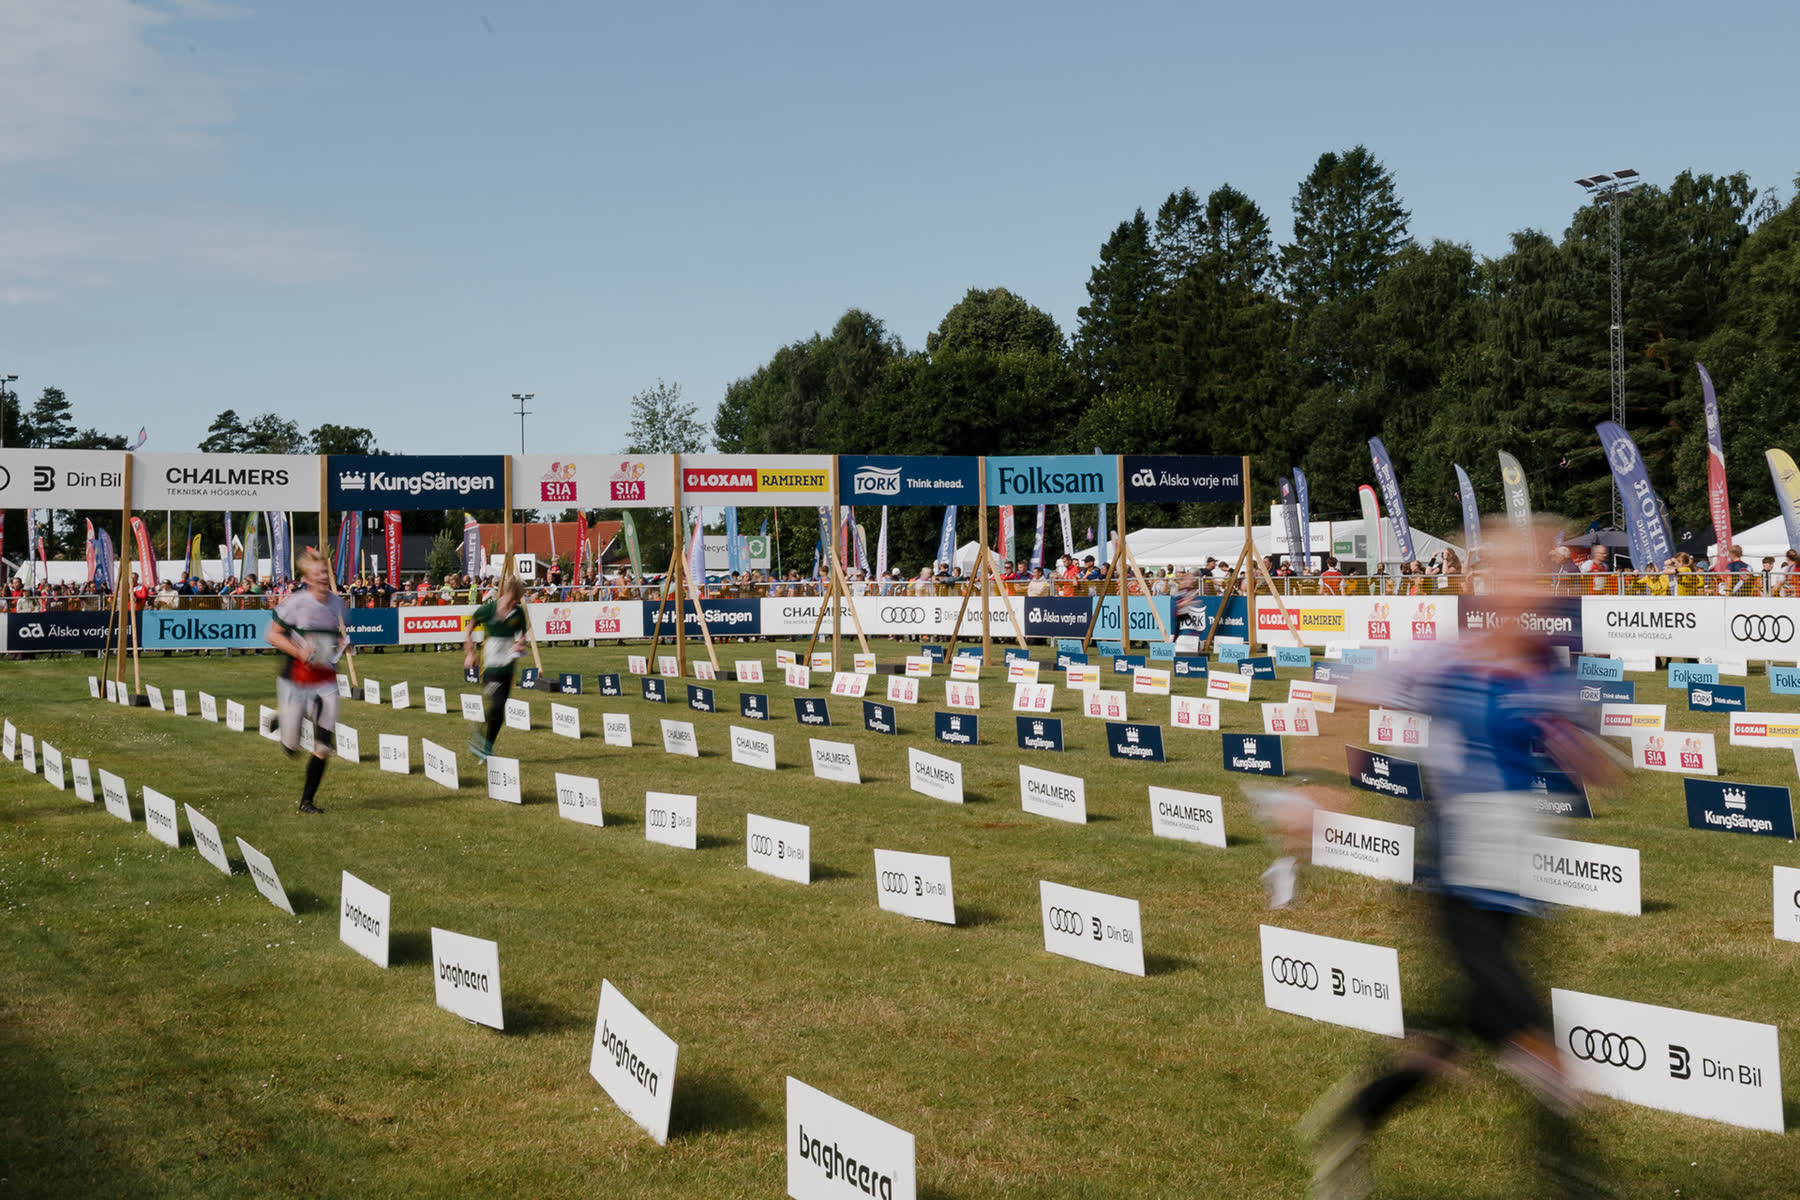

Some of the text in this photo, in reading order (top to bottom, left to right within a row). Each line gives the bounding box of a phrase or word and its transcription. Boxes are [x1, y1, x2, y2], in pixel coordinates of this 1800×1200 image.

[67, 472, 121, 488] Din Bil
[166, 468, 289, 486] CHALMERS
[370, 471, 494, 495] KungSängen
[762, 475, 825, 486] RAMIRENT
[857, 478, 964, 492] TORK Think ahead.
[998, 467, 1104, 495] Folksam
[1160, 471, 1189, 486] Älska
[1192, 474, 1219, 489] varje
[1222, 474, 1238, 486] mil
[167, 487, 258, 497] TEKNISKA HÖGSKOLA
[546, 484, 570, 496] SIA
[616, 482, 640, 496] SIA
[703, 544, 729, 553] Recycl
[599, 620, 616, 629] SIA
[1043, 609, 1060, 623] Älska
[1060, 612, 1076, 626] varje
[1077, 612, 1087, 623] mil
[1303, 615, 1342, 626] RAMIRENT
[1606, 611, 1696, 629] CHALMERS
[48, 624, 80, 637] Älska
[158, 618, 256, 640] Folksam
[356, 624, 384, 633] ahead.
[550, 622, 567, 630] SIA
[1371, 623, 1387, 634] SIA
[1416, 624, 1432, 634] SIA
[1279, 652, 1307, 663] Folksam
[1582, 663, 1618, 678] Folksam
[1674, 670, 1713, 684] Folksam
[1776, 674, 1800, 688] Folks
[1581, 690, 1600, 700] TORK
[1693, 694, 1712, 704] TORK
[736, 736, 769, 754] CHALMERS
[816, 750, 851, 766] CHALMERS
[1232, 757, 1271, 770] KungSängen
[1648, 751, 1662, 761] SIA
[1684, 754, 1700, 764] SIA
[915, 762, 955, 785] CHALMERS
[1028, 780, 1076, 803] CHALMERS
[1360, 772, 1408, 795] KungSängen
[1158, 802, 1214, 824] CHALMERS
[1704, 810, 1772, 832] KungSängen
[1324, 828, 1400, 857] CHALMERS
[1532, 853, 1624, 884] CHALMERS
[1107, 925, 1134, 944] Din Bil
[439, 957, 488, 995] bagheera
[1352, 978, 1390, 1001] Din Bil
[601, 1019, 659, 1097] bagheera
[1703, 1058, 1762, 1088] Din Bil
[799, 1125, 894, 1200] bagheera
